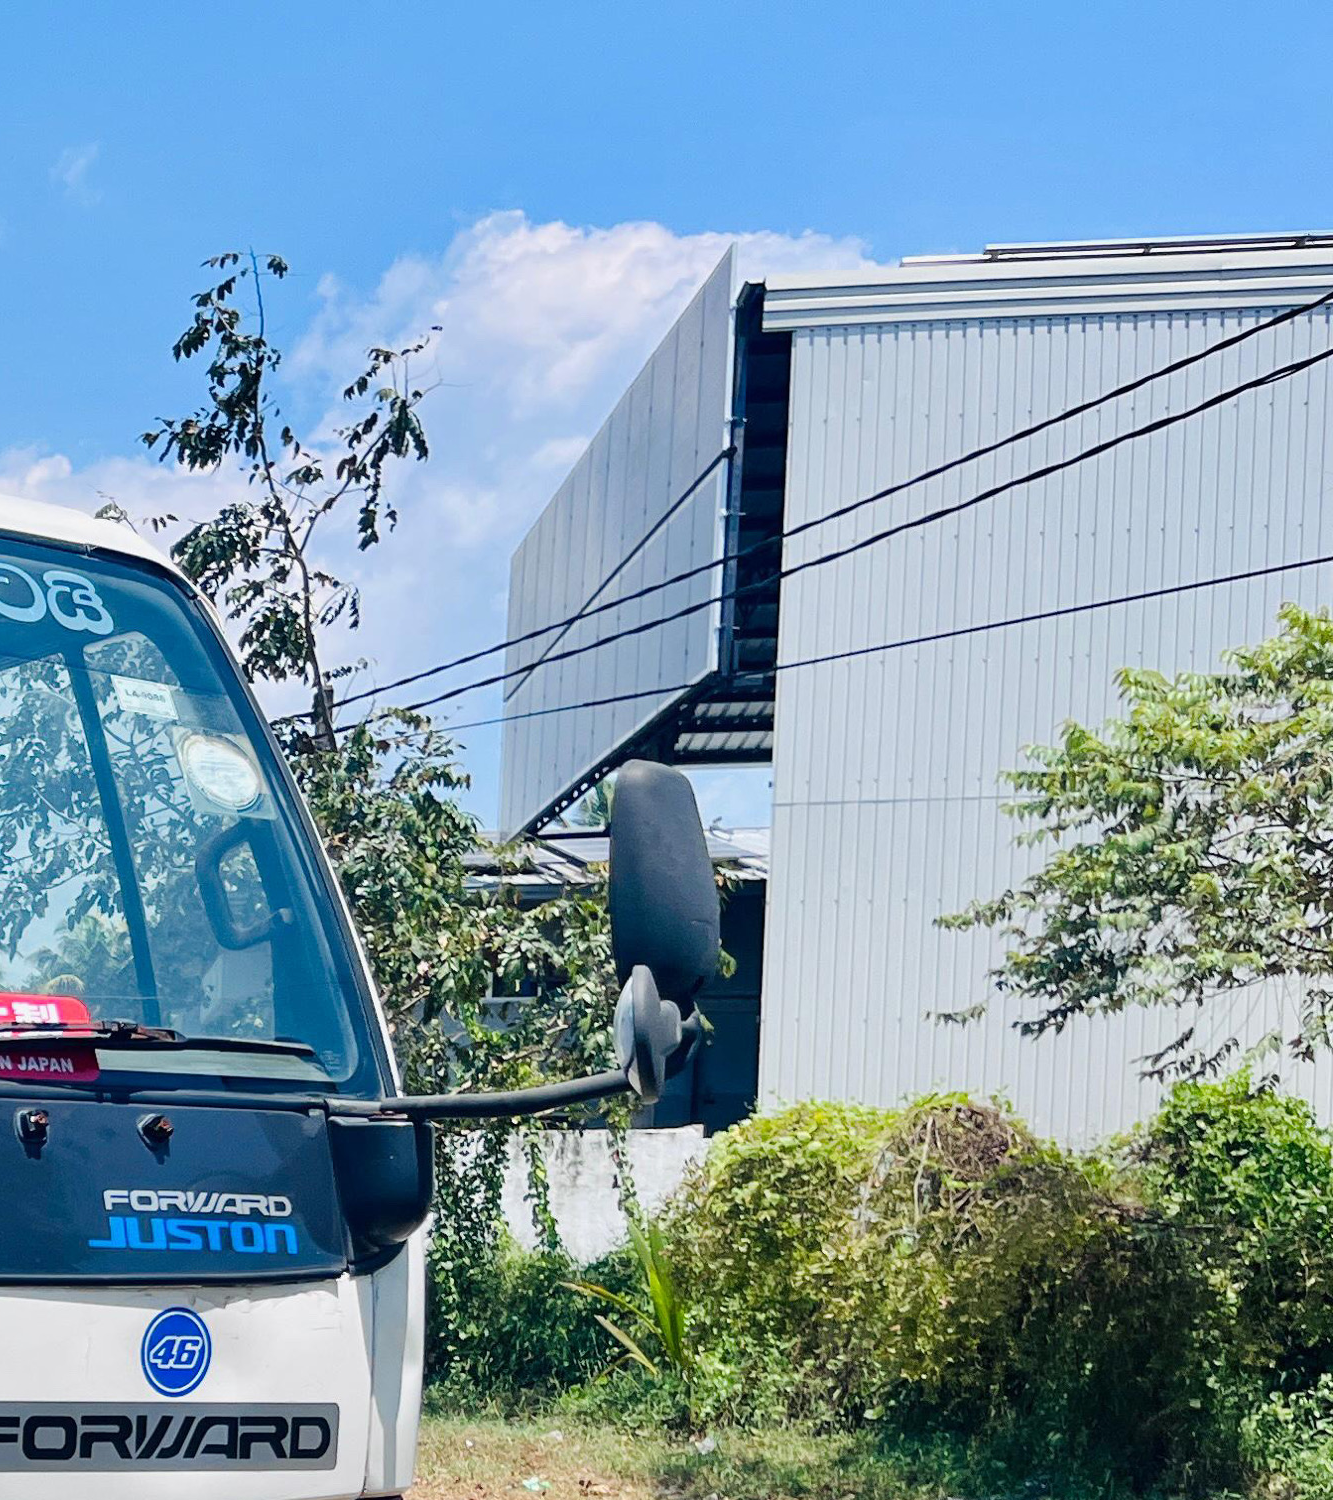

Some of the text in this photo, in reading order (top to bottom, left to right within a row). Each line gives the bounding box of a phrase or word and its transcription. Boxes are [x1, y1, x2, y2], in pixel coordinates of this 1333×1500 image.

[17, 1056, 74, 1074] JAPAN
[103, 1189, 293, 1217] FORWARD
[149, 1335, 203, 1370] 46
